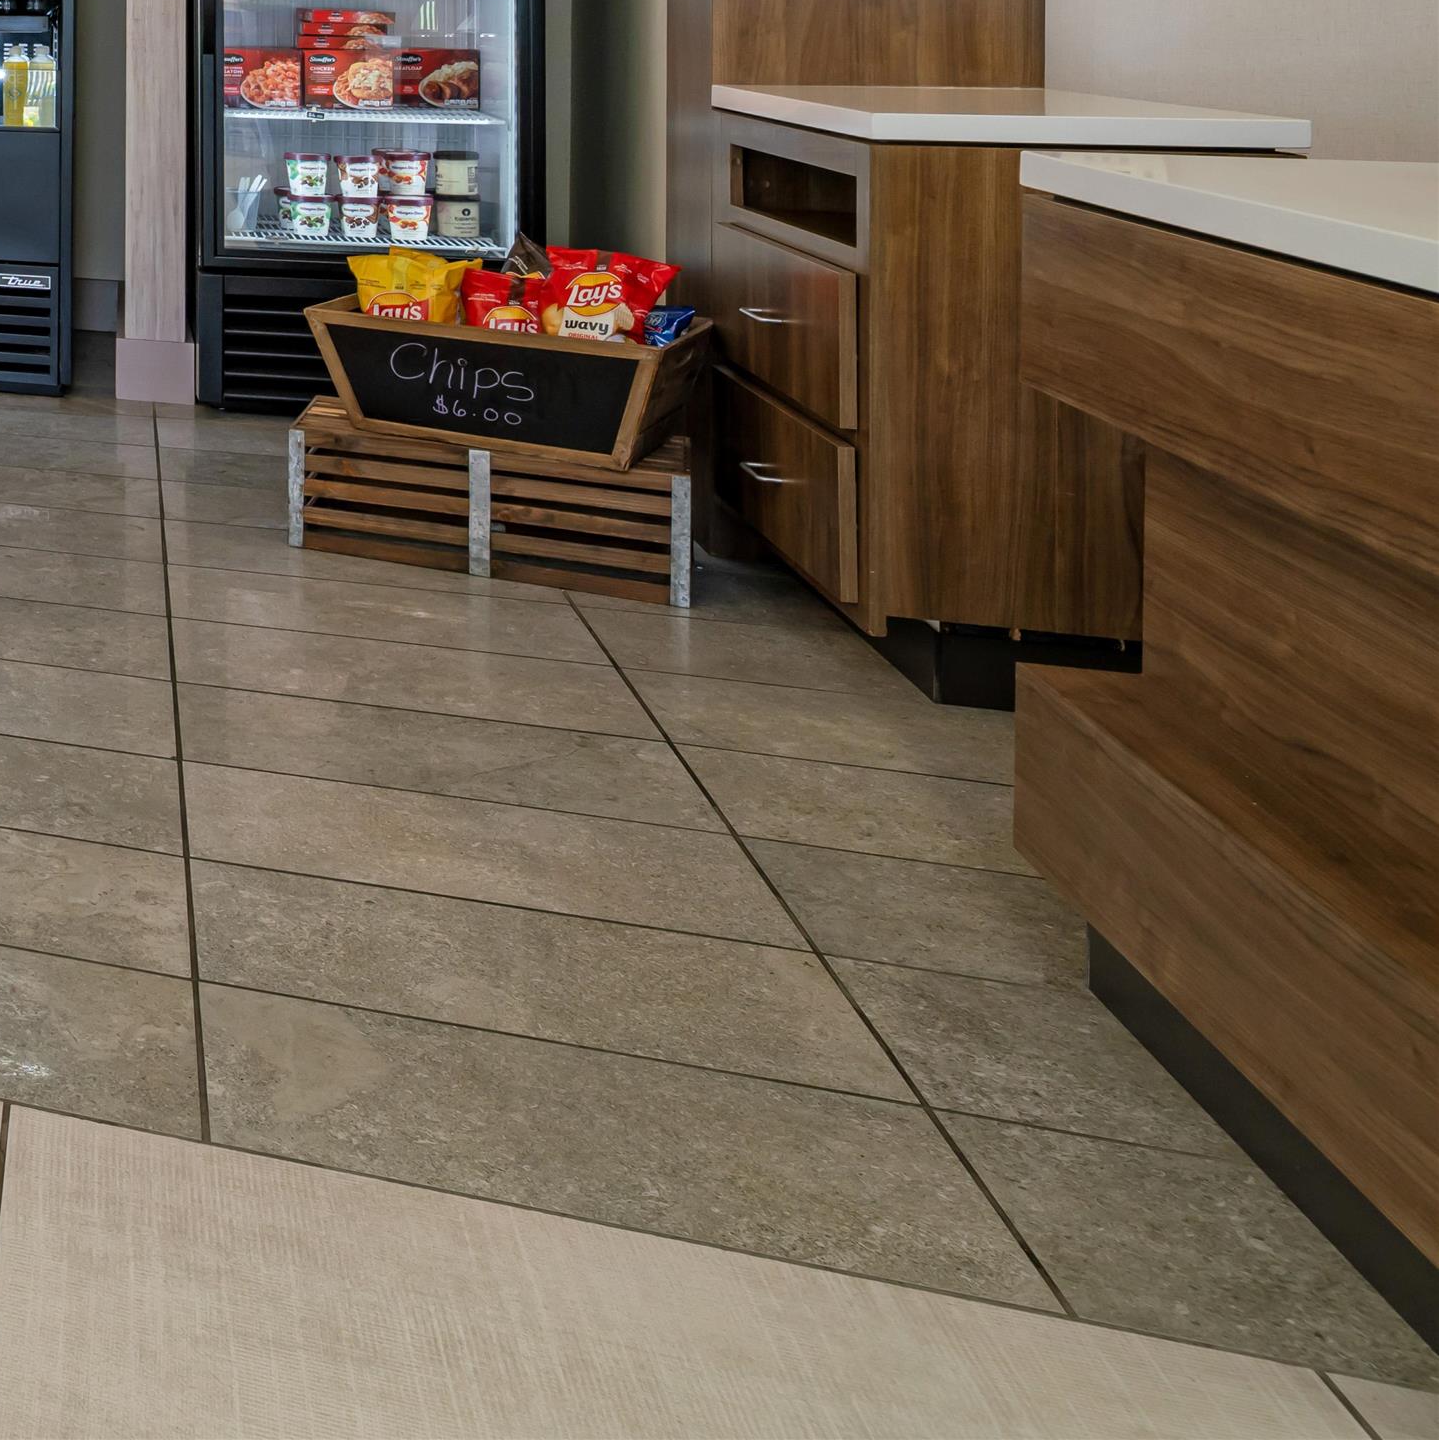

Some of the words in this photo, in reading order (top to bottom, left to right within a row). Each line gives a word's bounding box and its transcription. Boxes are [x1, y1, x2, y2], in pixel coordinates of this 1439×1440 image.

[2, 276, 45, 287] True
[566, 281, 622, 307] Lay's
[565, 319, 610, 336] wavy
[389, 341, 535, 402] Chips
[432, 394, 523, 426] $6.00
